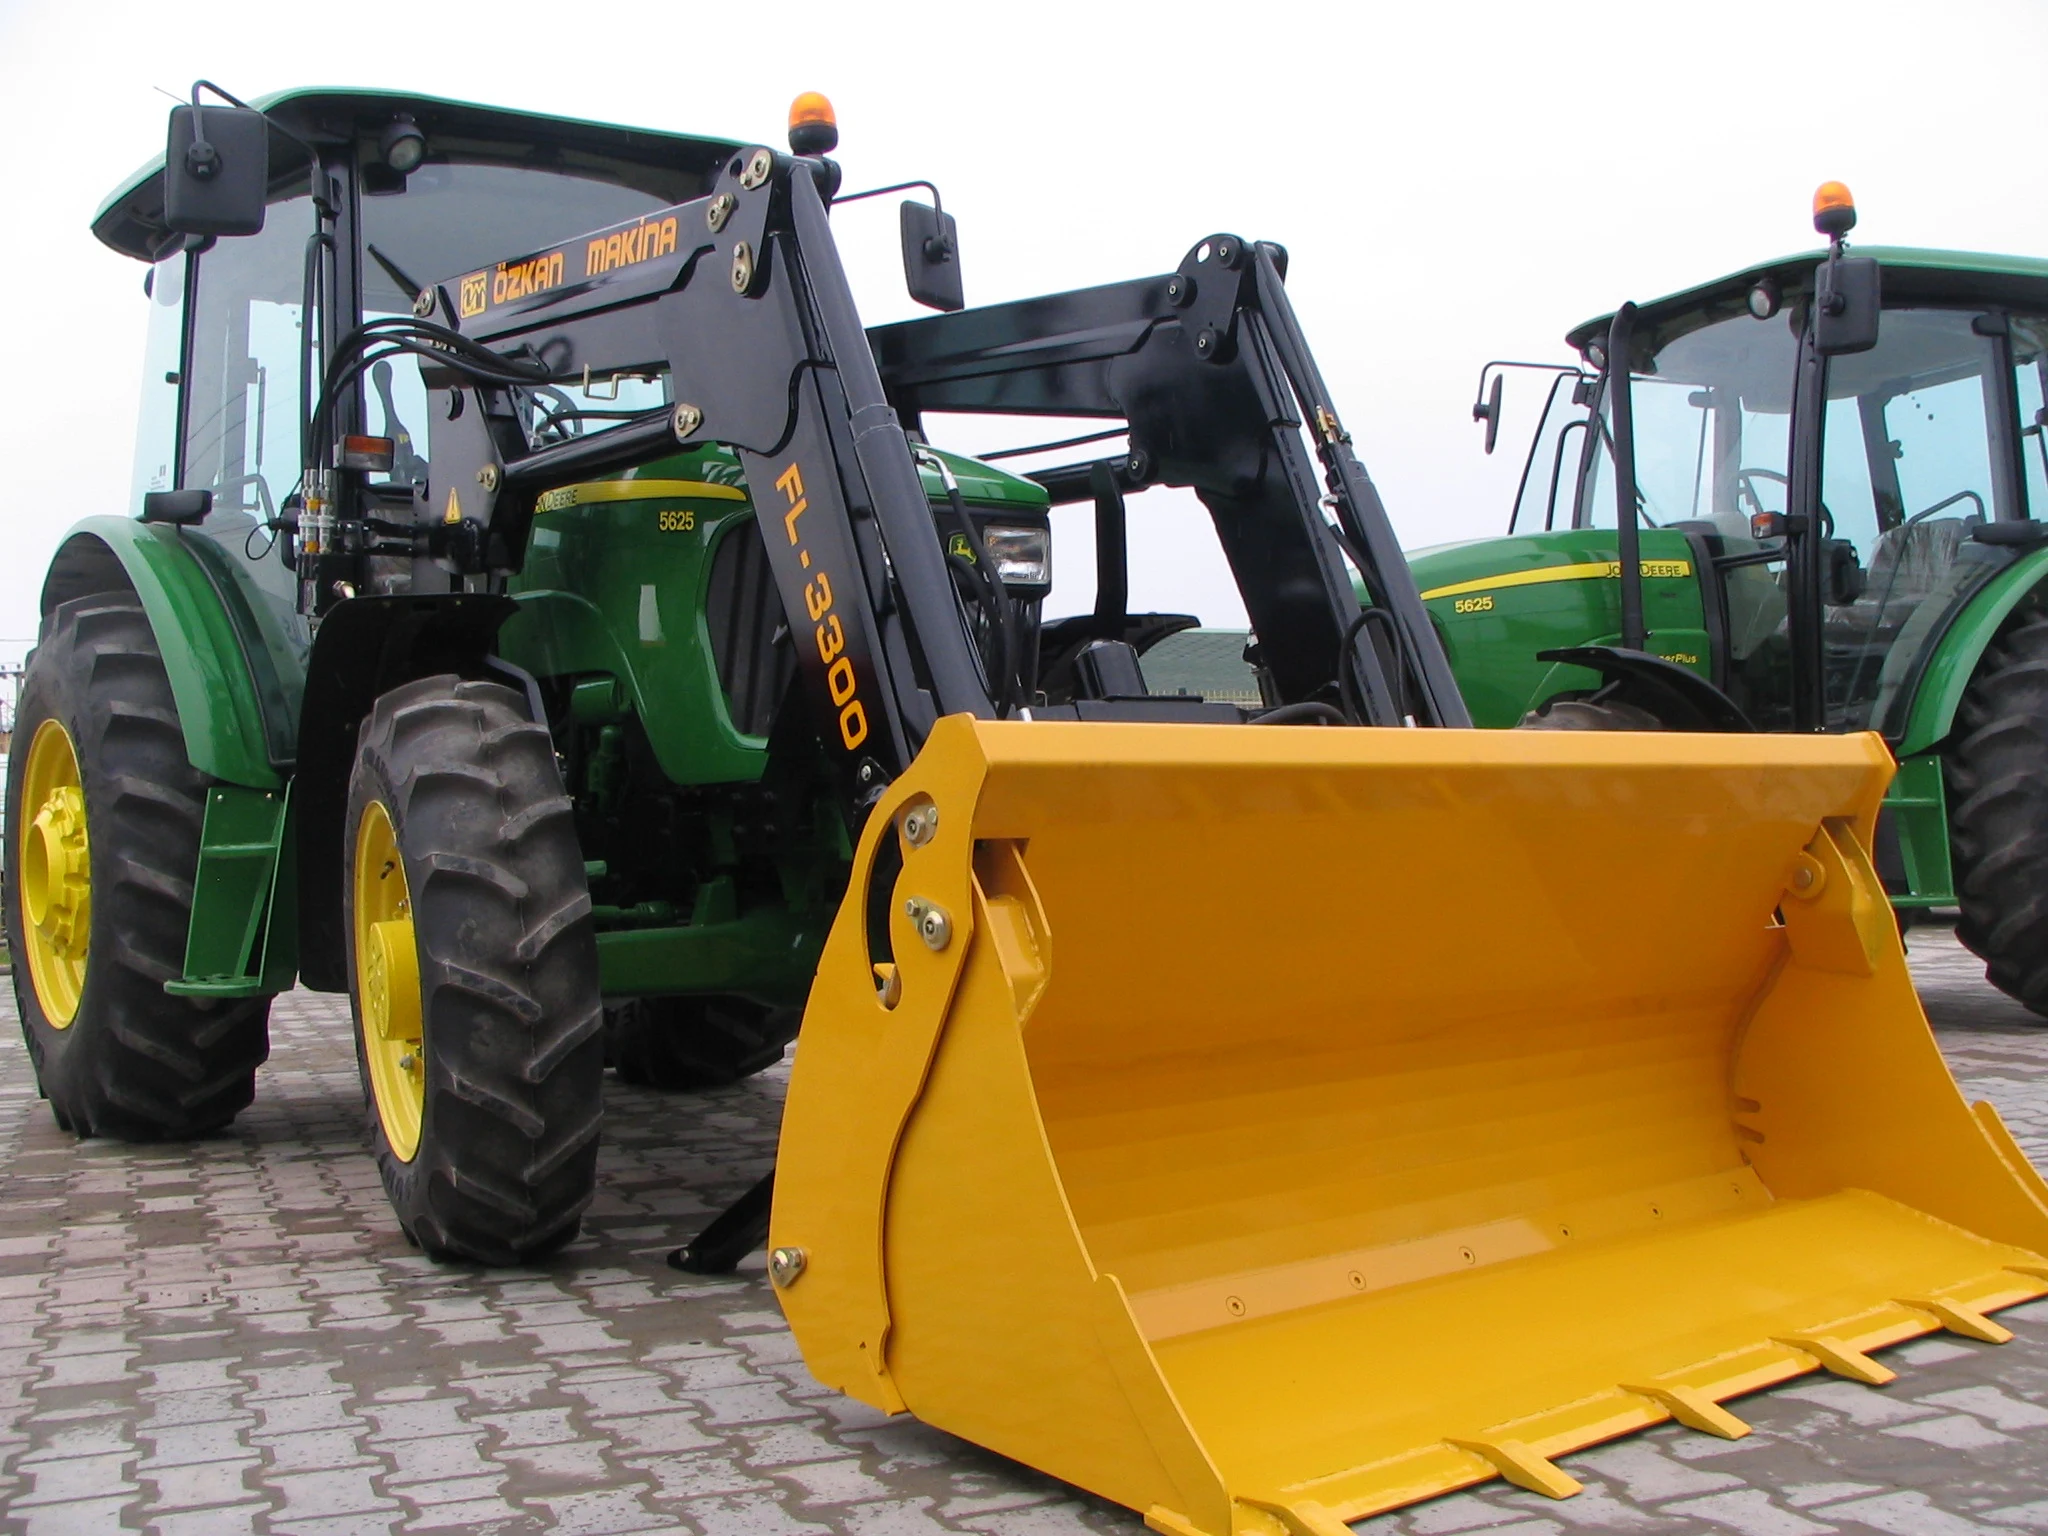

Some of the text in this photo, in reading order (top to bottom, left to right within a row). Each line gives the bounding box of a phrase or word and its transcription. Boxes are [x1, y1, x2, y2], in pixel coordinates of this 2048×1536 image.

[493, 252, 564, 304] ÖZKAN
[548, 489, 578, 510] DEERE
[659, 511, 695, 531] 5625
[1639, 563, 1682, 577] DEERE
[1454, 596, 1493, 613] 5625
